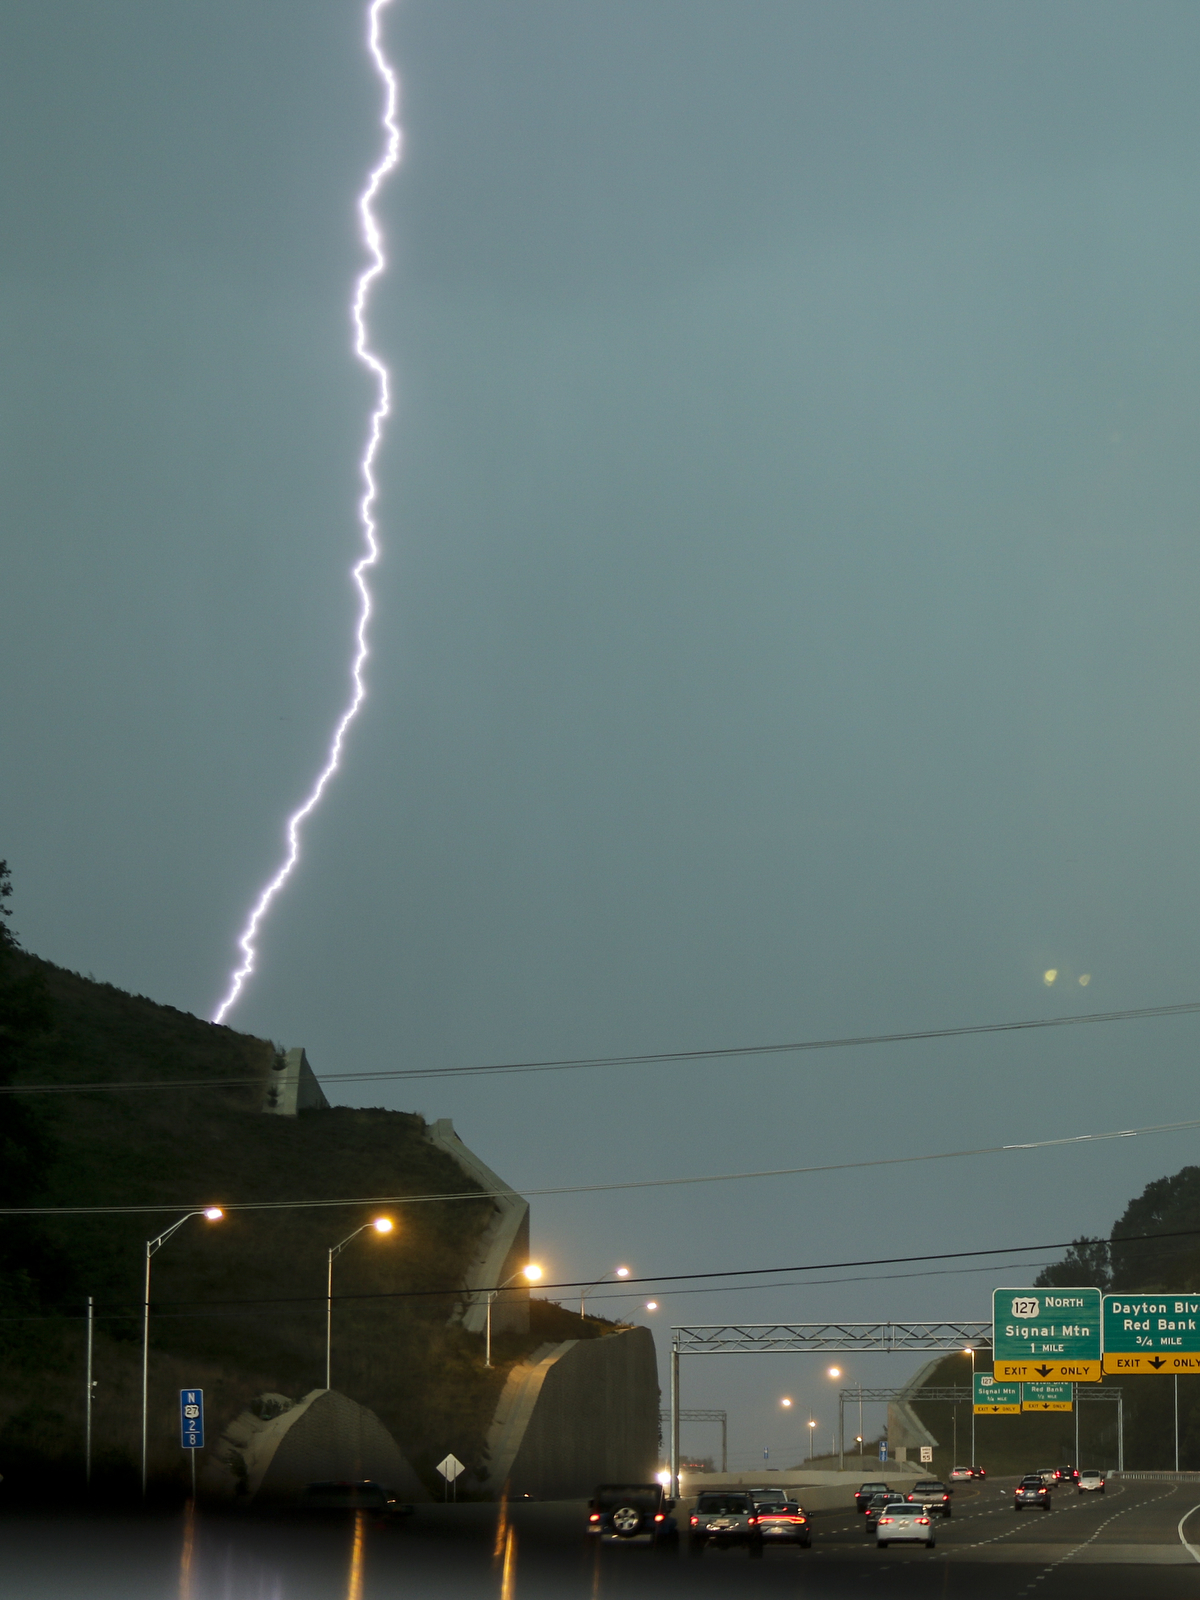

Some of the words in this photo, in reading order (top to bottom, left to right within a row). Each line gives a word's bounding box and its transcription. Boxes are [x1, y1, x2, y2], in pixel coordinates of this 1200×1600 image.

[1014, 1301, 1036, 1314] 127
[1045, 1297, 1084, 1307] NORTH
[1112, 1302, 1167, 1316] Dayton
[1123, 1319, 1150, 1331] Red
[1158, 1318, 1196, 1331] Bank
[1005, 1325, 1055, 1340] Signal
[1062, 1325, 1090, 1337] Mtn
[1160, 1337, 1182, 1346] MILE
[1030, 1343, 1035, 1353] 1
[1042, 1344, 1064, 1352] MILE
[1117, 1359, 1140, 1368] EXIT
[1004, 1367, 1028, 1376] EXIT
[1060, 1367, 1090, 1376] ONLY
[188, 1392, 195, 1403] N
[978, 1388, 1000, 1396] Signal
[186, 1406, 198, 1415] 27
[189, 1420, 196, 1431] 2
[189, 1434, 196, 1445] 8
